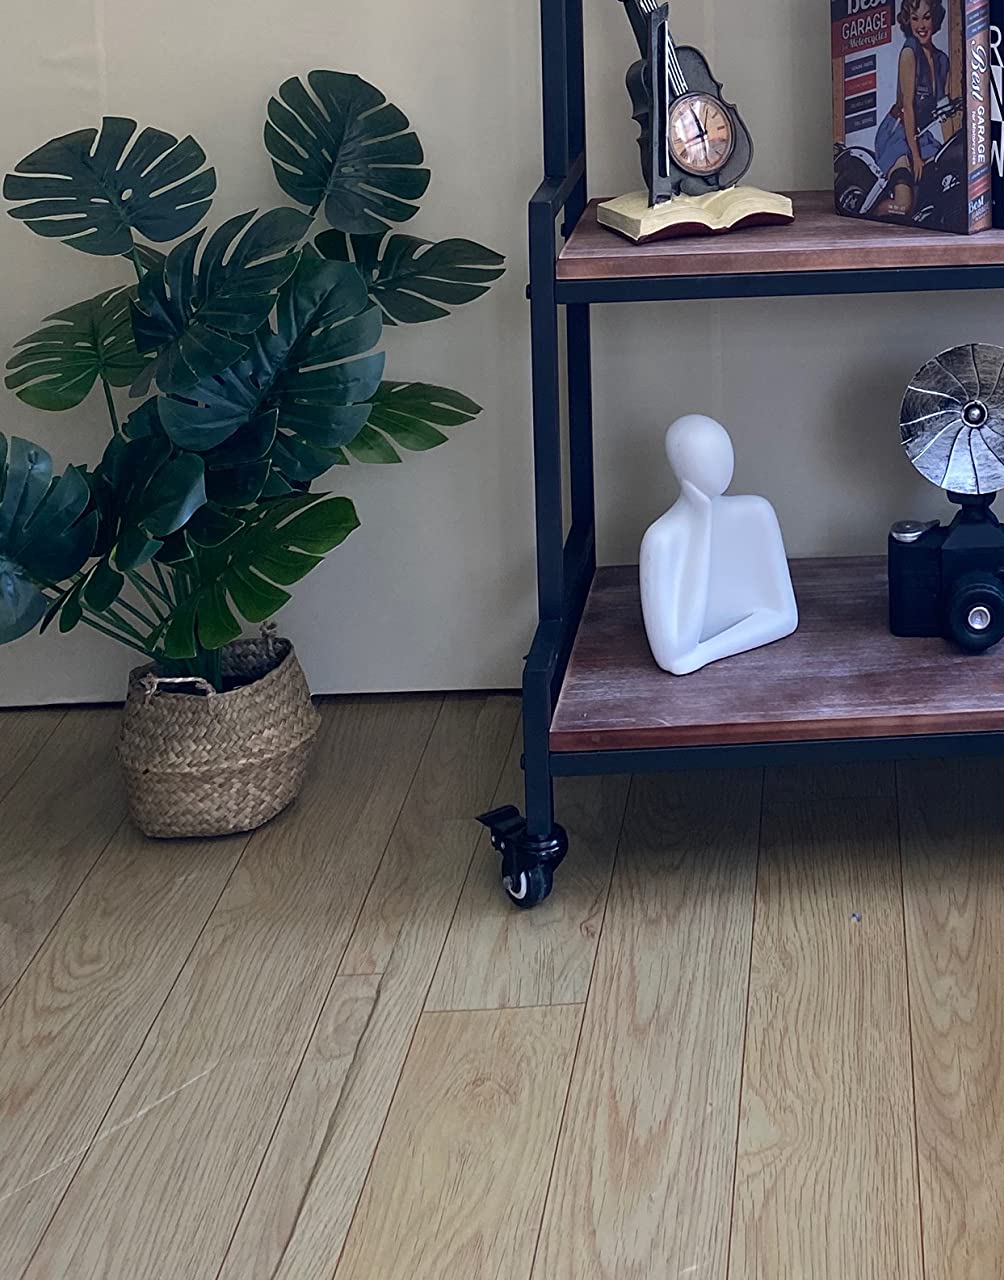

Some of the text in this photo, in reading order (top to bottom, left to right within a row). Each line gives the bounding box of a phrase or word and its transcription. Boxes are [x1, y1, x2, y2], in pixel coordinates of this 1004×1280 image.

[842, 11, 888, 39] GARAGE
[971, 40, 987, 103] Best
[977, 105, 985, 163] GARAGE
